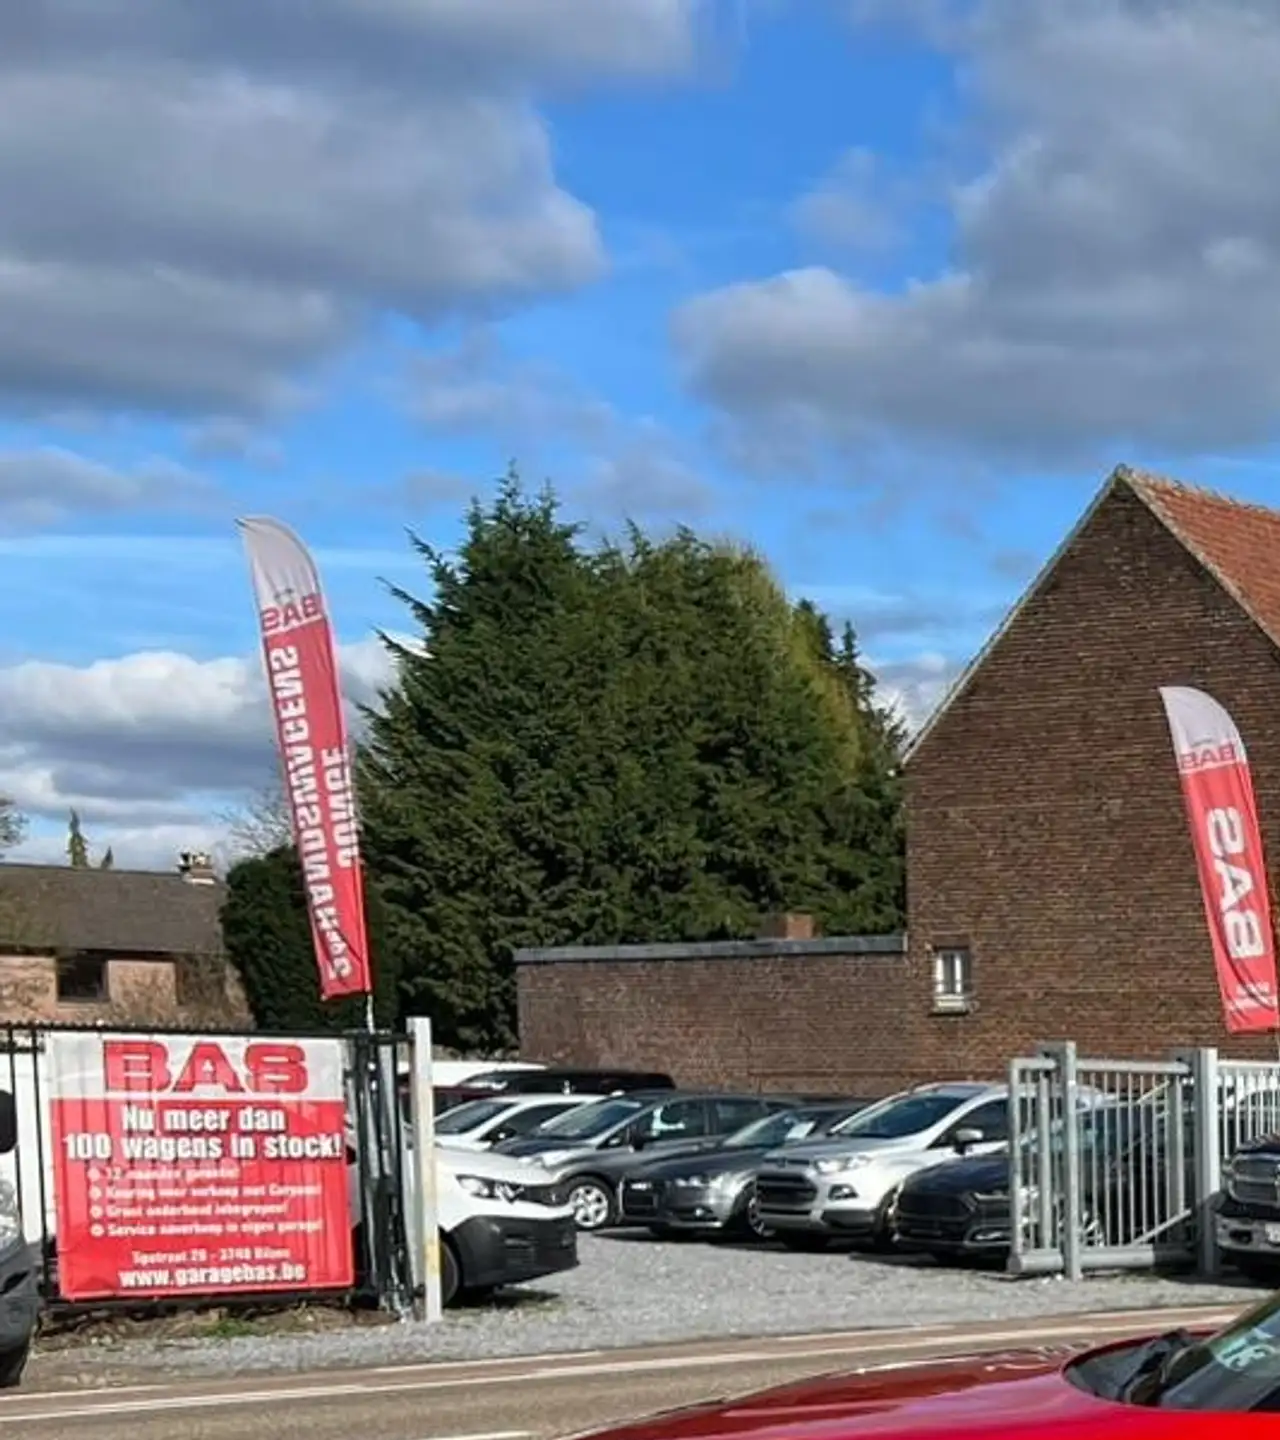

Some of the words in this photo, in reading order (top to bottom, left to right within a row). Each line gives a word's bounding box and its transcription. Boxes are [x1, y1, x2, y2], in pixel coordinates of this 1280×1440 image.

[103, 1040, 309, 1093] BAS
[121, 1104, 154, 1131] Nu
[164, 1107, 230, 1131] meer
[239, 1106, 285, 1131] dan
[64, 1133, 111, 1159] 100
[120, 1135, 222, 1161] wagens
[230, 1133, 256, 1157] in
[264, 1133, 342, 1158] stock!
[118, 1263, 306, 1287] www.garagebas.be
